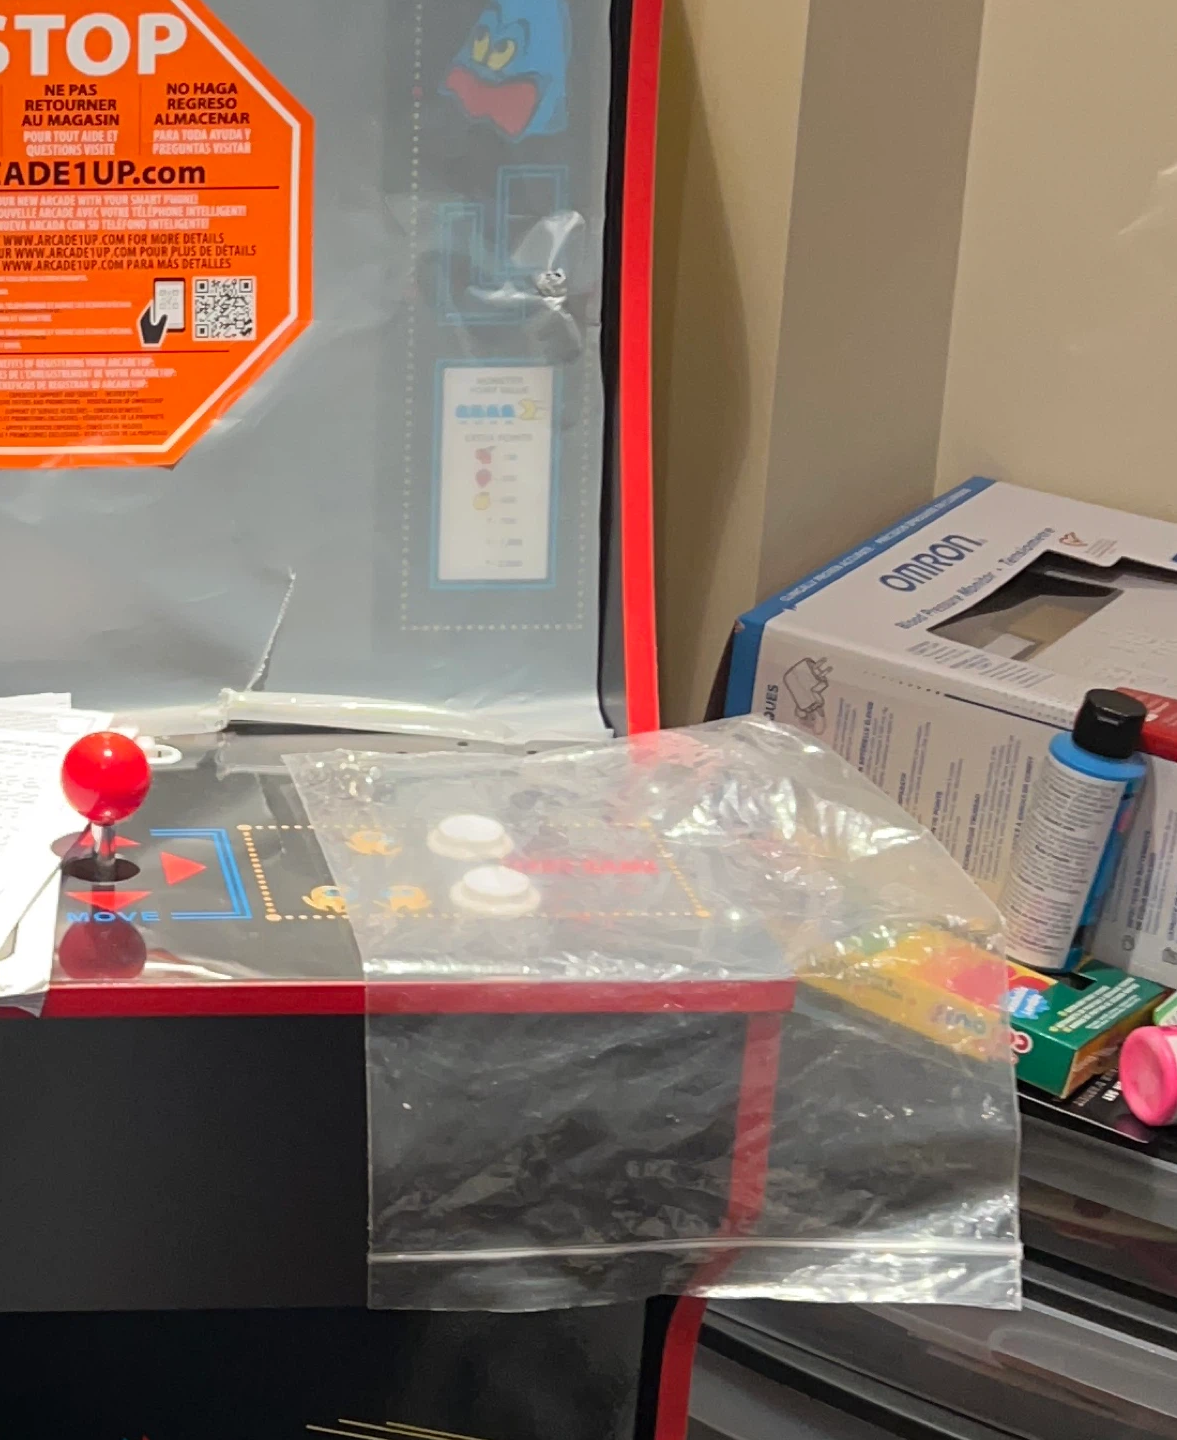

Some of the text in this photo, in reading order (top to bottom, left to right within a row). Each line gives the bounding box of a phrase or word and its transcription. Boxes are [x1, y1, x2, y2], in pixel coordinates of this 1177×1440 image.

[44, 84, 97, 96] NE PAS
[166, 82, 237, 95] NO HAGA
[25, 99, 117, 112] RETOURNER
[167, 97, 237, 110] REGRESO
[22, 114, 119, 126] AU MAGASIN
[154, 112, 250, 125] ALMACENAR
[24, 130, 118, 143] POUR TOUT AIDE ET
[153, 129, 179, 141] PARA
[209, 128, 243, 141] AYUDA
[26, 143, 115, 157] QUESTIONS VISITE
[152, 143, 211, 155] PREGUNTAS
[128, 234, 147, 245] FOR
[151, 233, 179, 245] MORE
[183, 233, 224, 244] DETAILS
[140, 246, 169, 258] POUR
[171, 246, 197, 258] PLUS
[200, 246, 213, 257] DE
[127, 259, 154, 270] PARA
[182, 257, 231, 269] DETALLES
[879, 534, 982, 592] OMRON
[956, 571, 996, 598] Monitor
[66, 911, 160, 922] MOVE
